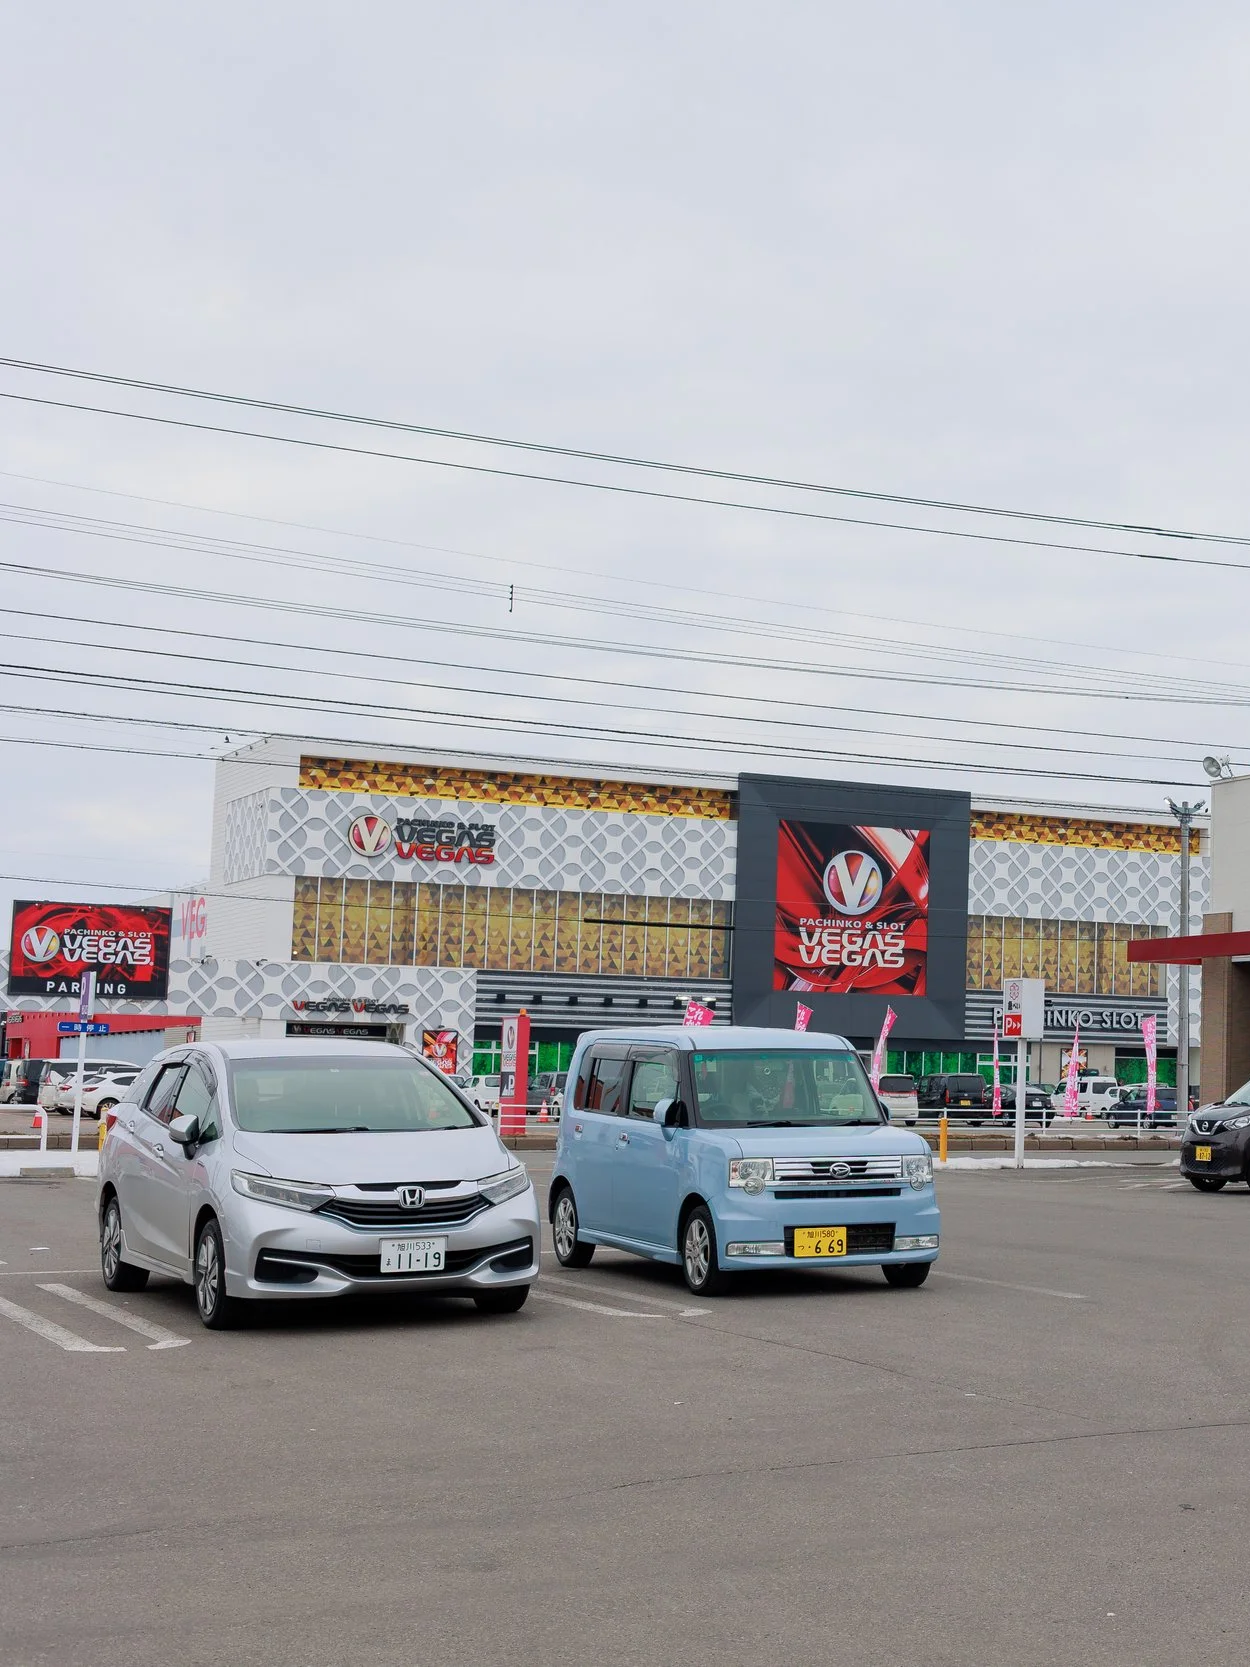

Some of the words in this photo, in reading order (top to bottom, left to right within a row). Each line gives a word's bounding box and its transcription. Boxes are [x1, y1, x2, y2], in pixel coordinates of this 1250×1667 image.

[397, 818, 455, 829] PACHINKO
[467, 823, 496, 831] SLOT
[394, 825, 496, 848] VEGAS
[394, 842, 495, 865] VEGAS
[181, 896, 208, 941] VEG
[799, 917, 862, 929] PACHINKO
[864, 920, 874, 930] &
[876, 921, 906, 931] SLOT
[64, 928, 116, 937] PACHINKO
[798, 926, 906, 951] VEGAS
[63, 934, 152, 952] VEGAS
[62, 947, 152, 965] VEGAS
[798, 944, 905, 968] VEGAS
[46, 981, 127, 995] PARING
[292, 1000, 351, 1013] VEGAS
[353, 1001, 410, 1014] VEGAS
[993, 1007, 1095, 1028] PINKO
[1101, 1011, 1144, 1029] SLOT
[61, 1023, 107, 1033] 一時停止
[398, 1251, 441, 1269] 11-19
